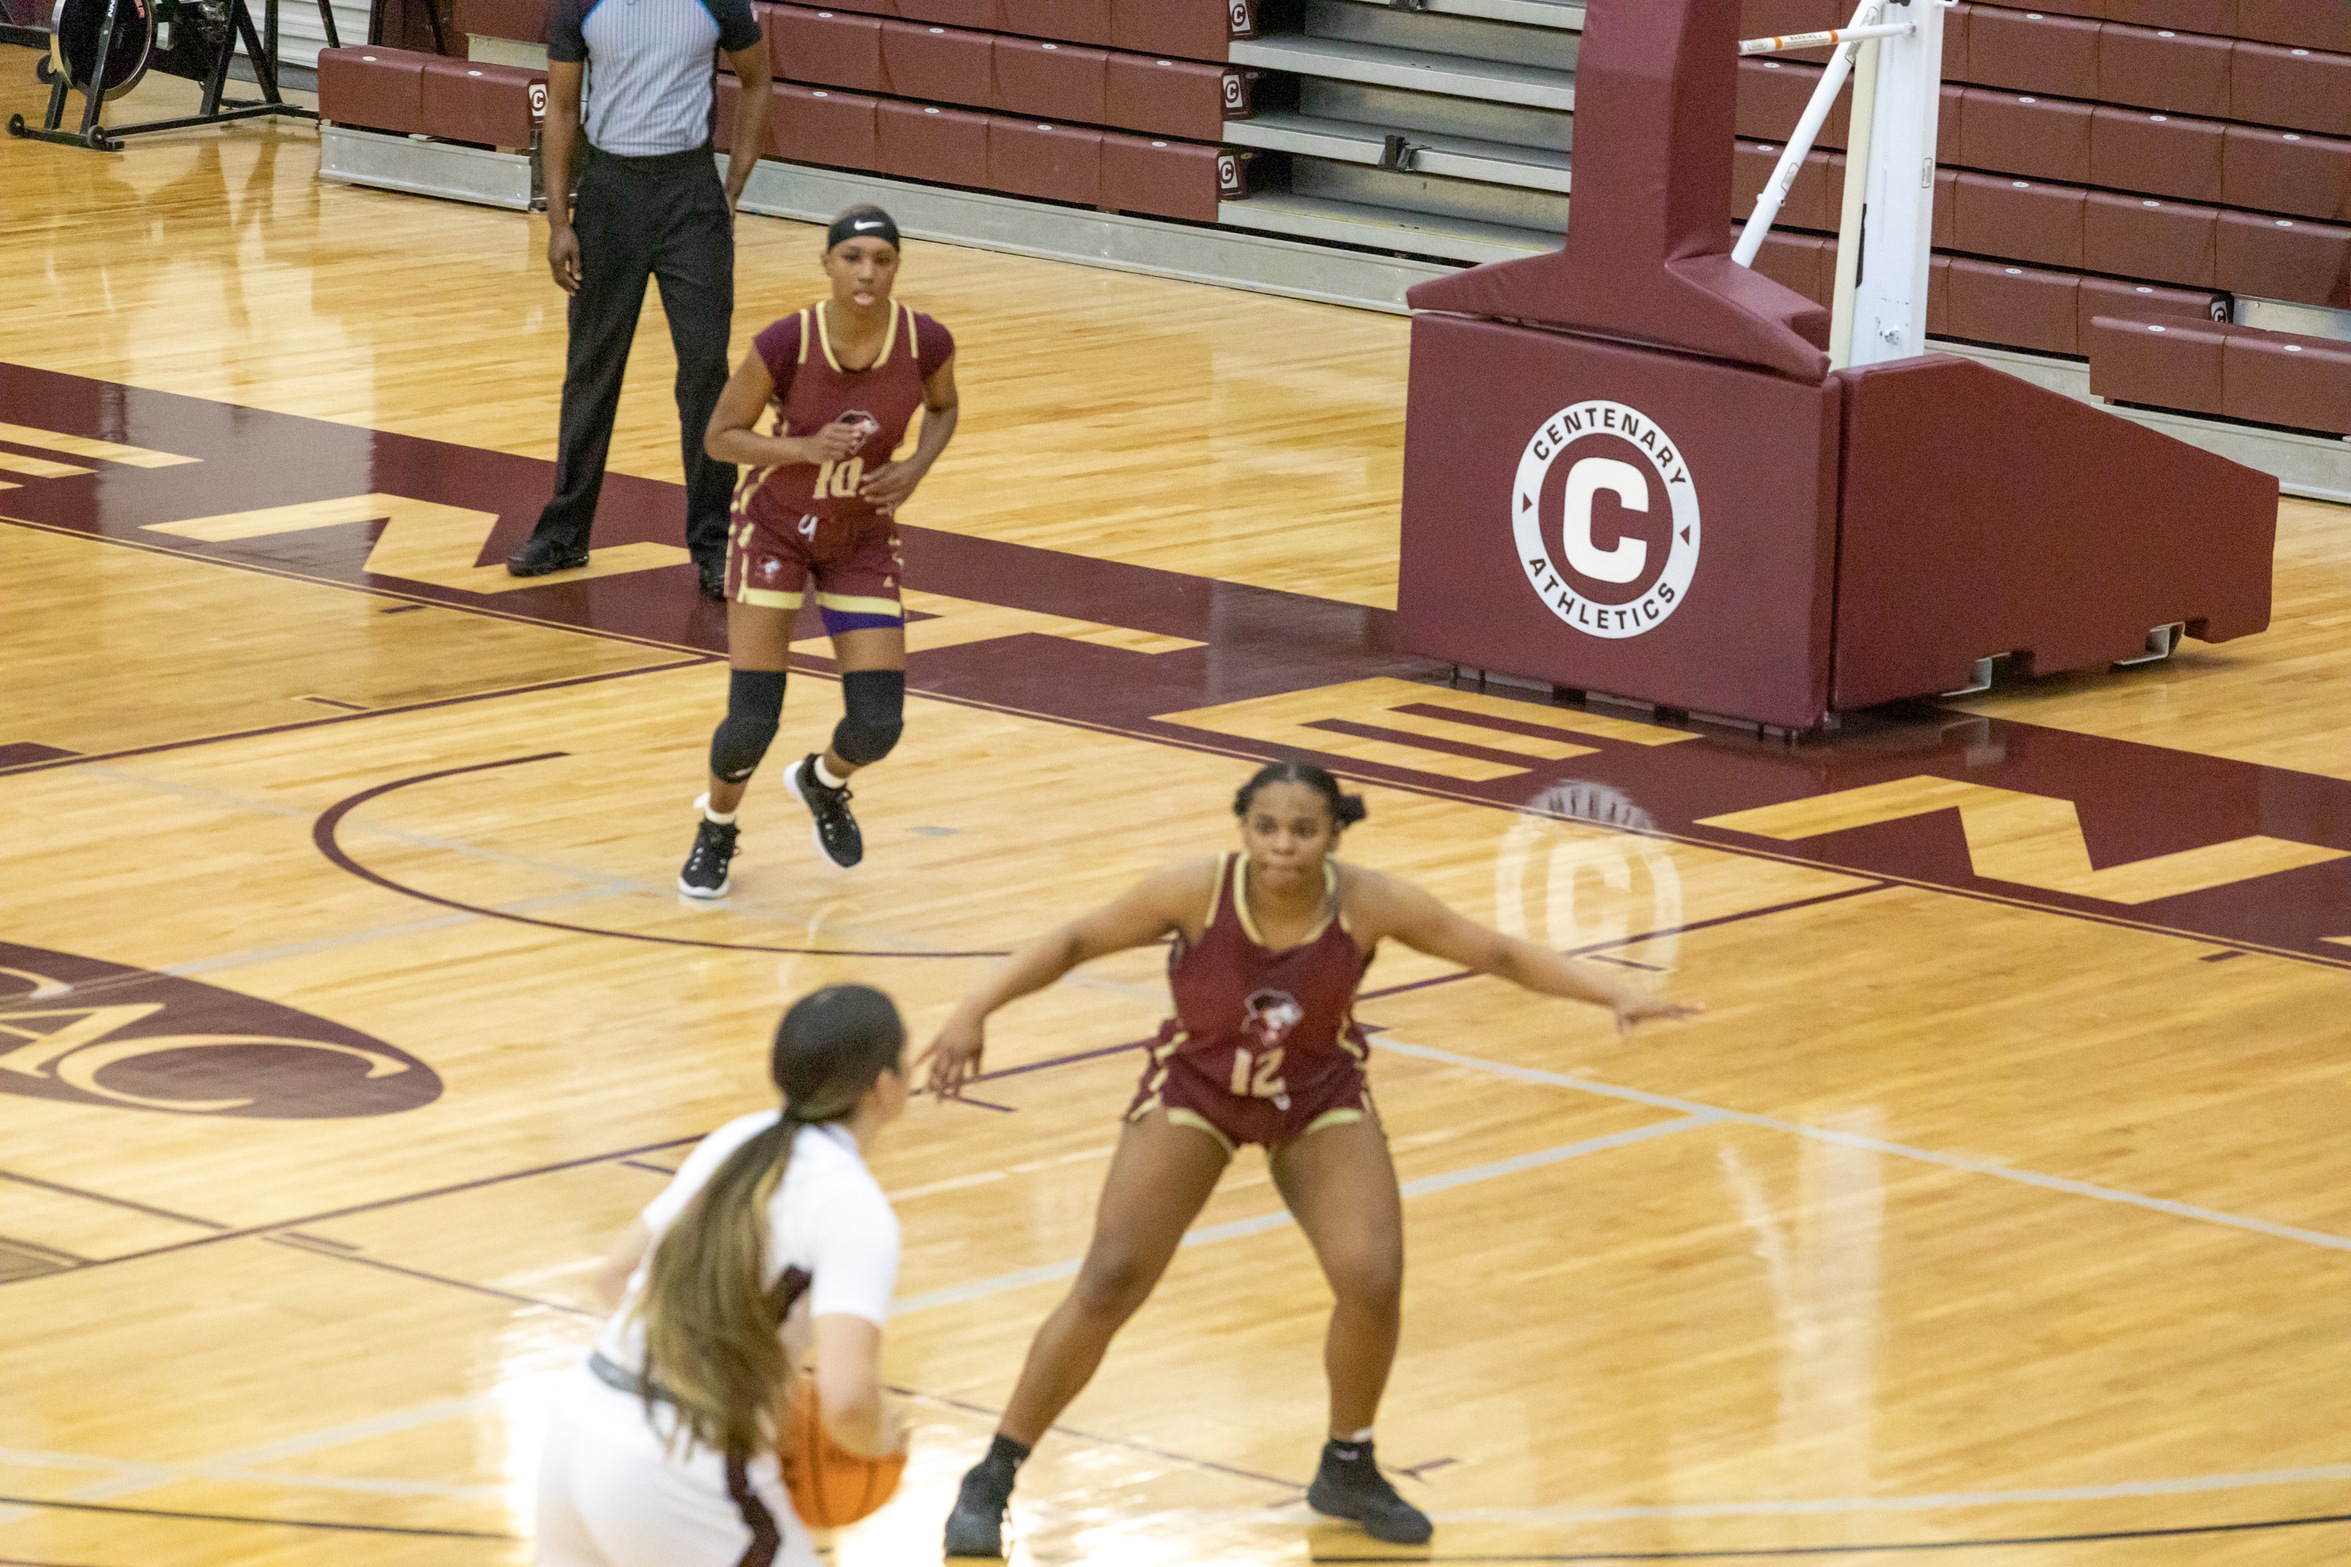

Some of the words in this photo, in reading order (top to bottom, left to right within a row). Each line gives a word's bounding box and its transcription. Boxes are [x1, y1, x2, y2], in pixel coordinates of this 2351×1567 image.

[812, 456, 864, 499] 10
[1533, 407, 1687, 484] CENTENARY
[1562, 456, 1649, 584] C
[1528, 556, 1676, 630] ATHLETICS
[1230, 1047, 1287, 1097] 12
